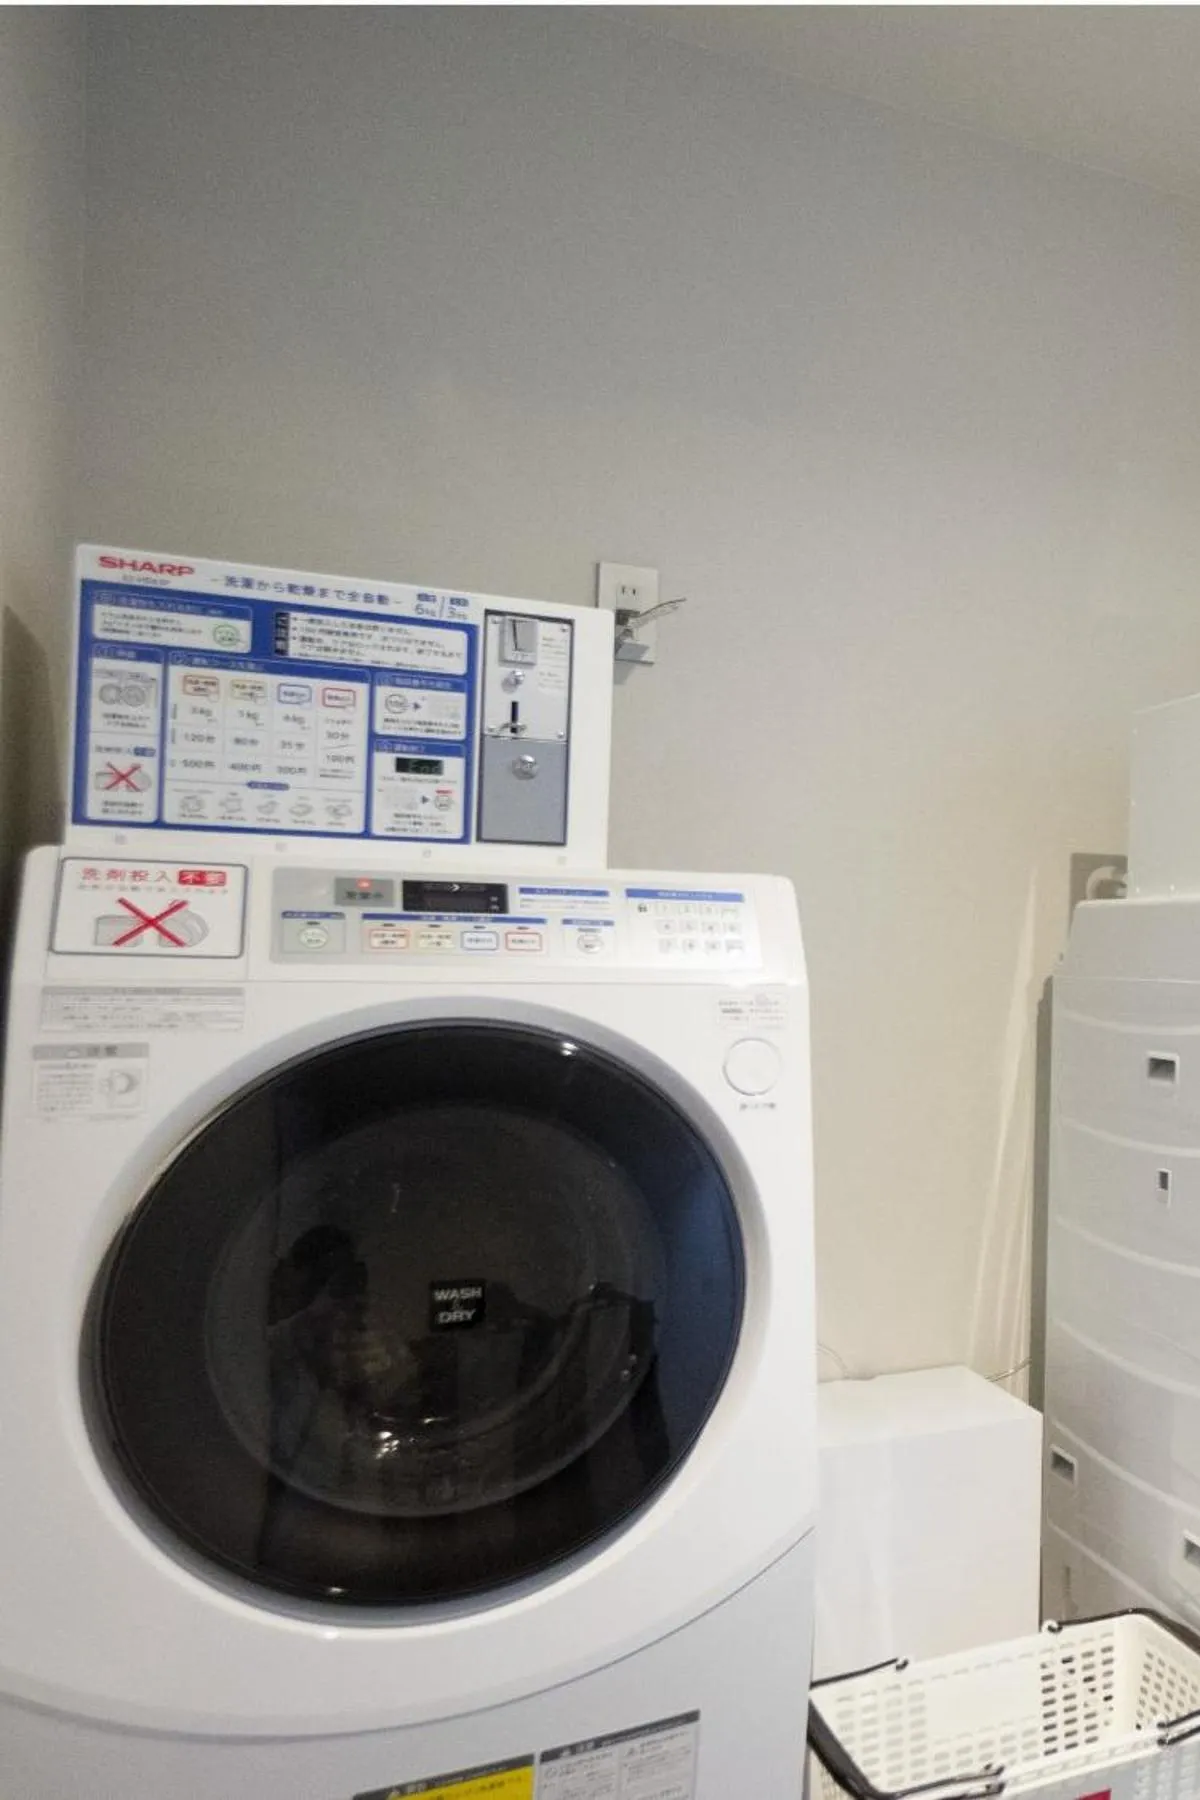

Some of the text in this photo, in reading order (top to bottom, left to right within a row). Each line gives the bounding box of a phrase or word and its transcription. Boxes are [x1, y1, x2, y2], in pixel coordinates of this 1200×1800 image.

[98, 555, 195, 577] SHARP
[434, 1287, 482, 1301] WASH
[438, 1309, 477, 1324] DRY
